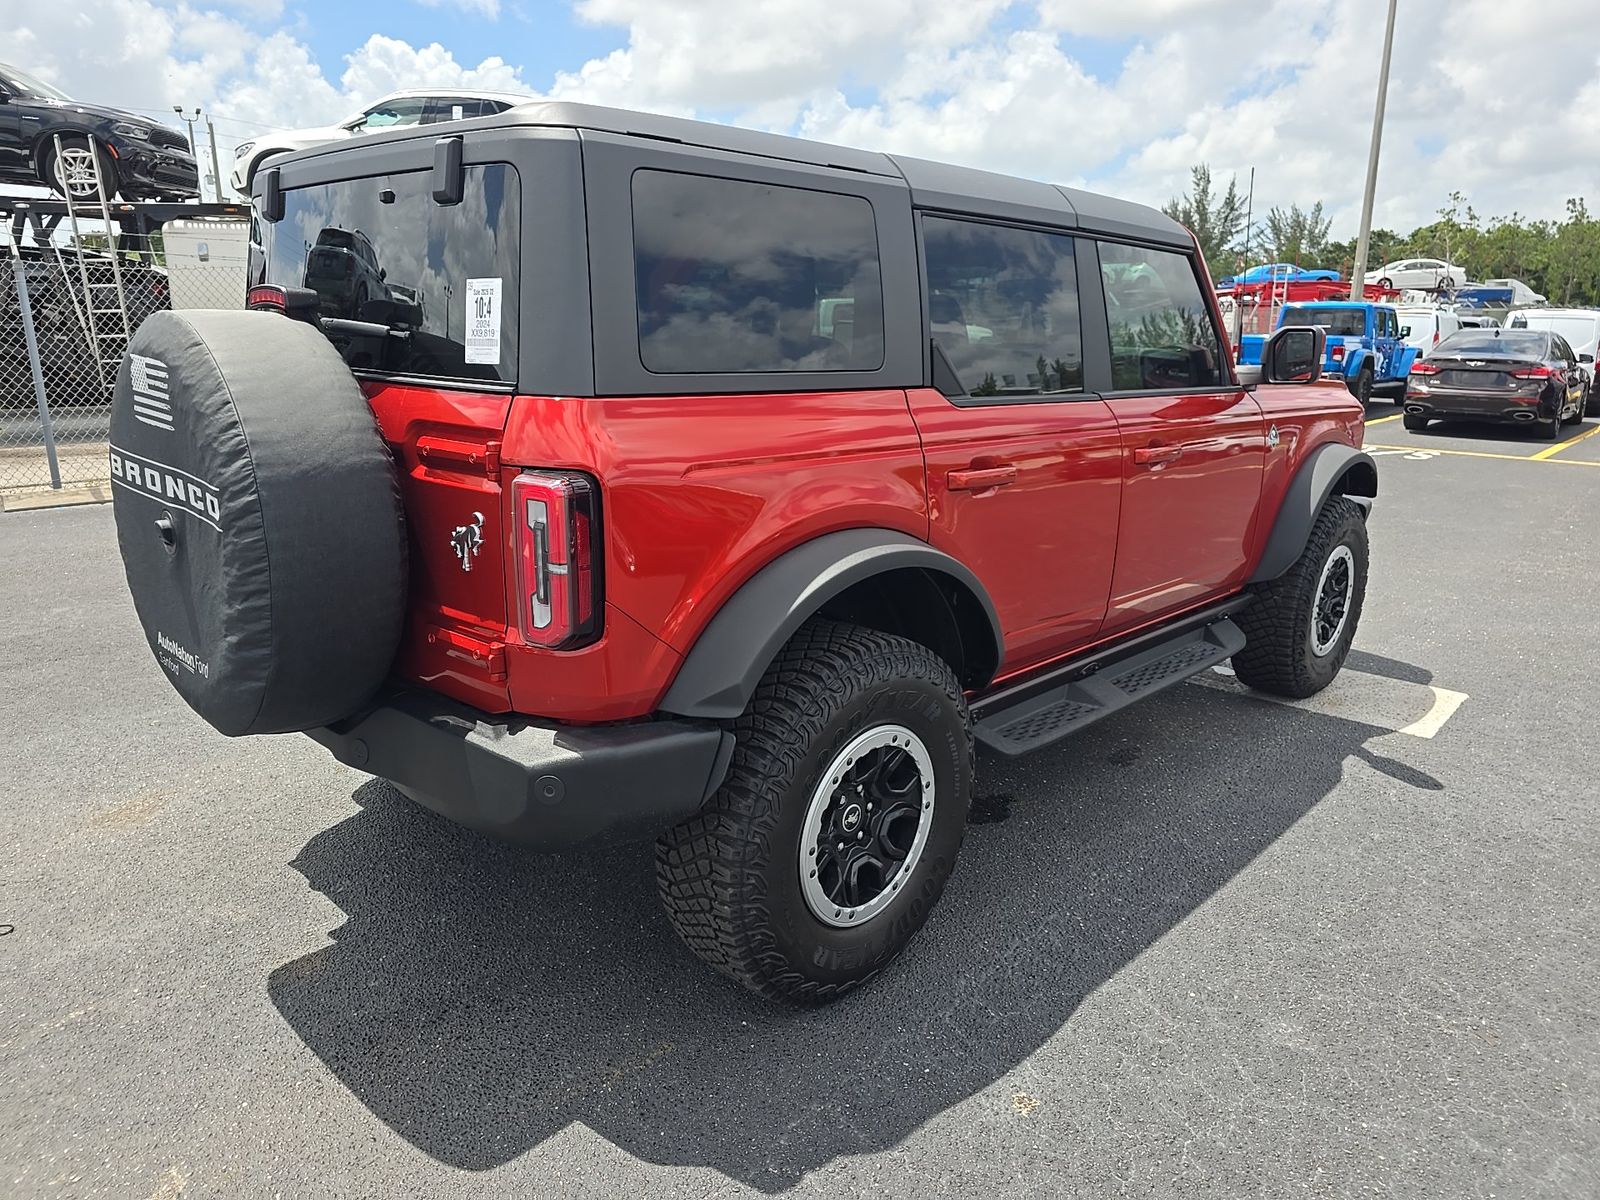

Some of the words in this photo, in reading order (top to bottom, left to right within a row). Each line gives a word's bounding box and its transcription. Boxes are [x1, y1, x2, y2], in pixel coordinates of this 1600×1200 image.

[475, 297, 491, 319] 10:4
[476, 320, 490, 328] 2024
[110, 453, 219, 522] BRONCO
[157, 630, 196, 669] AutoNation
[194, 654, 209, 680] Ford
[158, 651, 180, 677] Sanford
